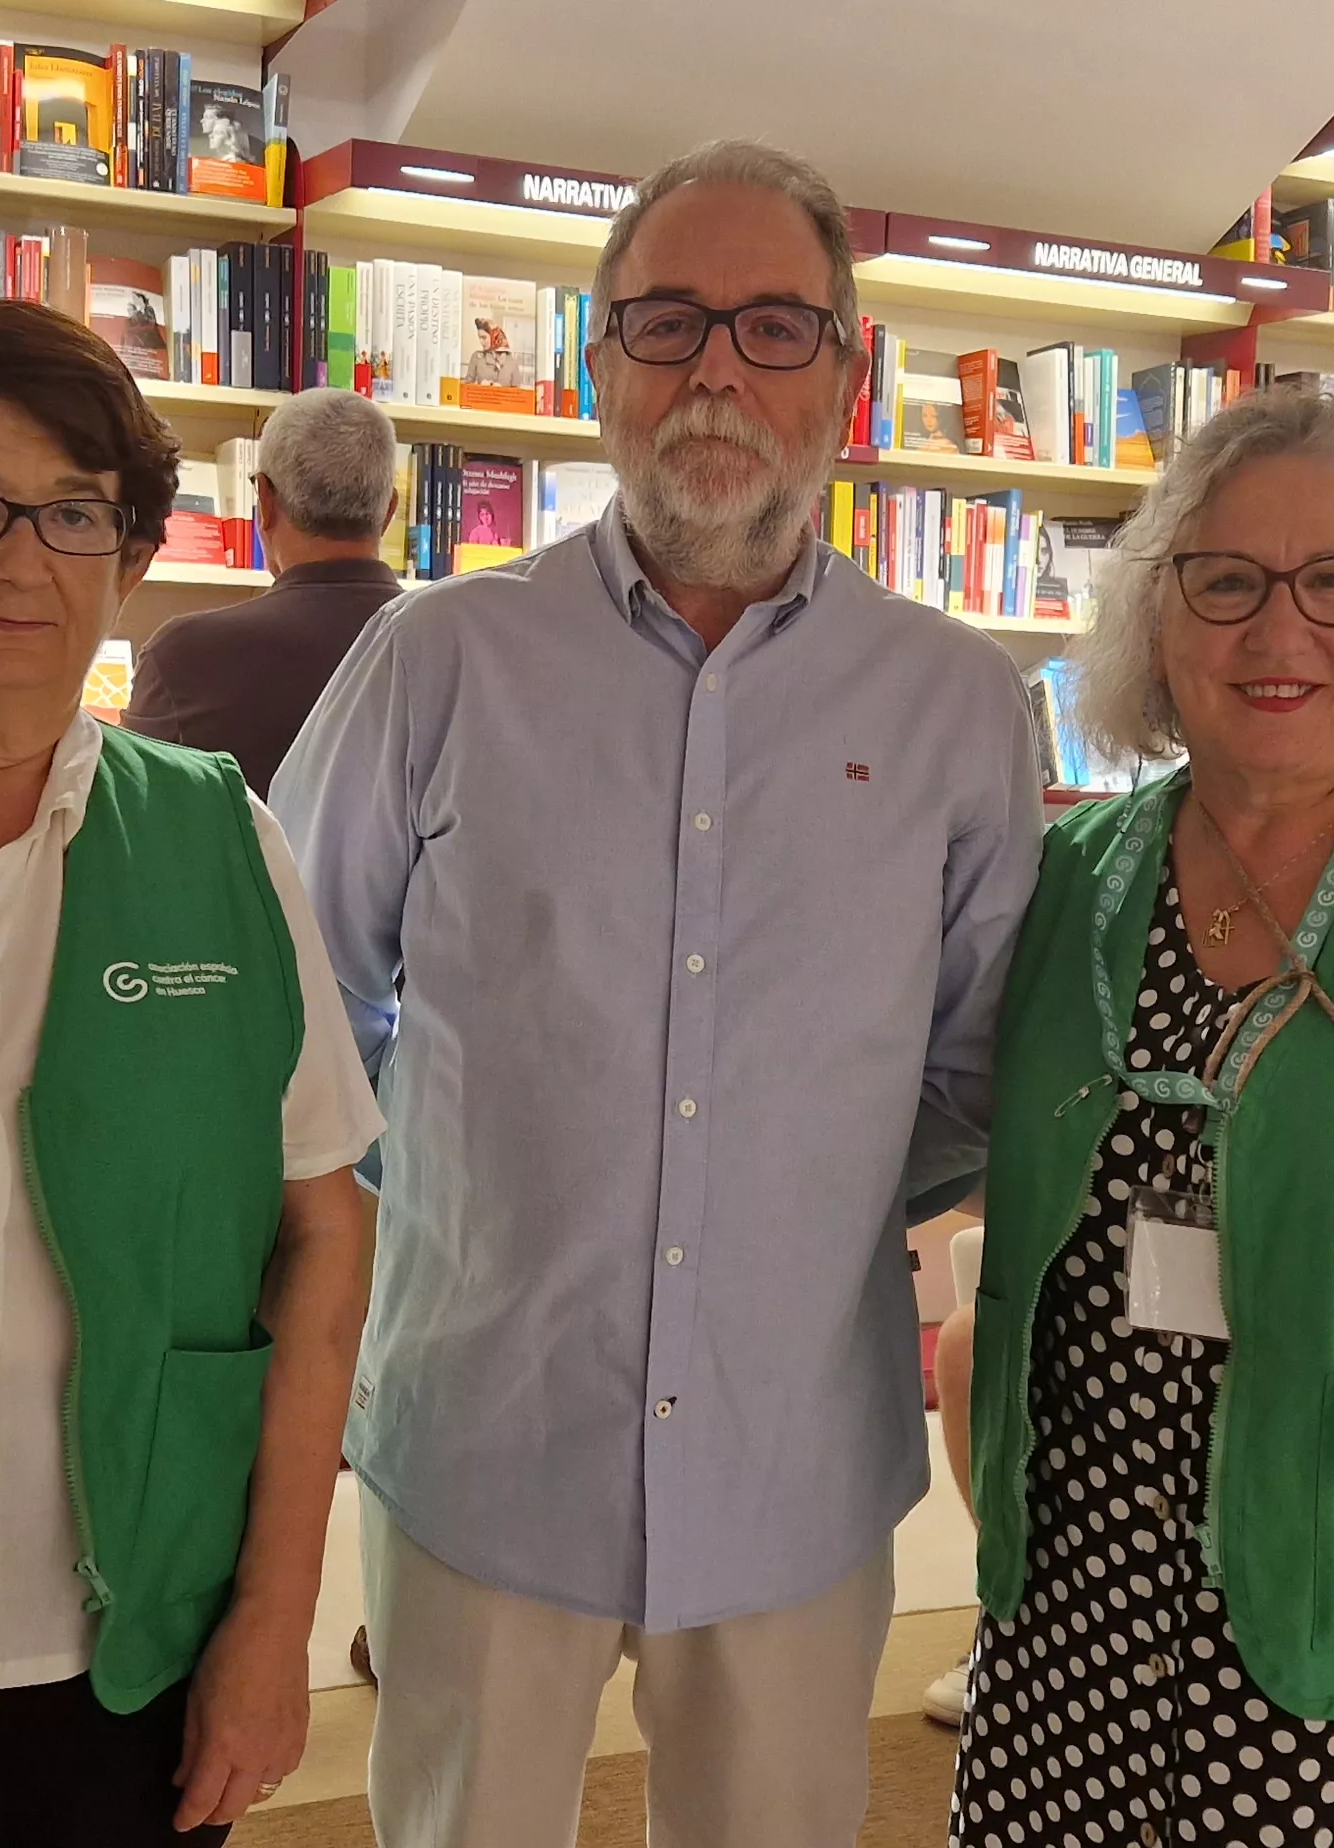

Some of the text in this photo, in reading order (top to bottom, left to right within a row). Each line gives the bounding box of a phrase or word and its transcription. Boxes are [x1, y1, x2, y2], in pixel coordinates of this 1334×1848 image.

[523, 173, 637, 211] NARRATIVA
[1034, 241, 1204, 287] NARRATIVA GENERAL
[148, 961, 199, 973] asociación
[152, 974, 182, 984] contra
[183, 973, 194, 983] el
[155, 986, 206, 997] en Huesca
